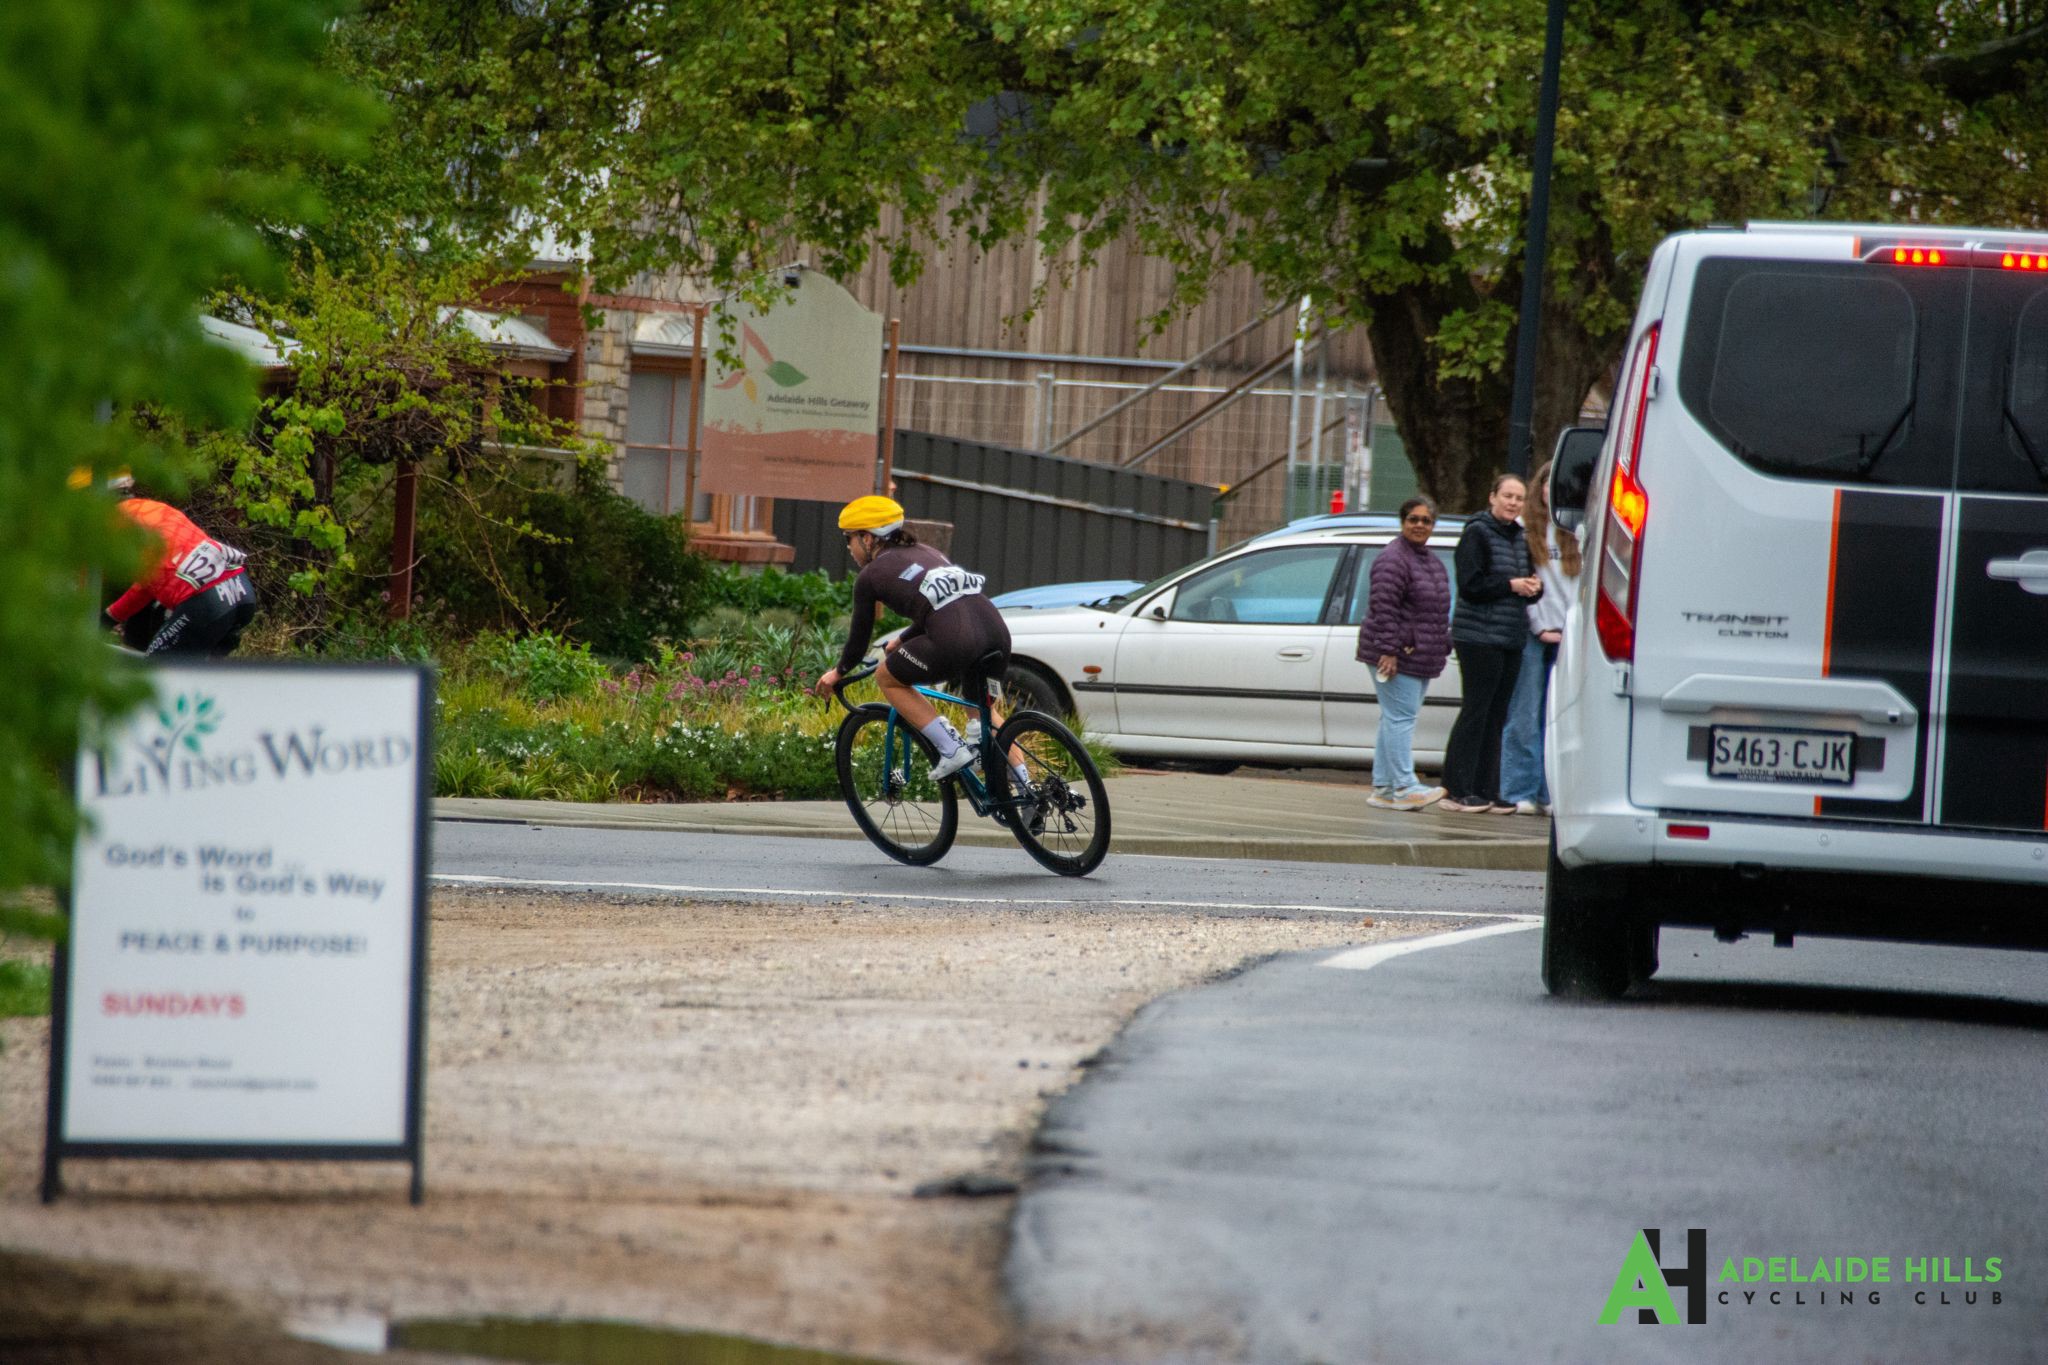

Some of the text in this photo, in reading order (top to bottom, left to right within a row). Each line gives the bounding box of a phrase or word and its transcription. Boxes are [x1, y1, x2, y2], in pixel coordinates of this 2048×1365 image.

[767, 394, 870, 411] Adelaide Hills Getaway
[183, 553, 217, 584] 122
[927, 574, 959, 604] 205
[162, 614, 190, 641] PANTRY
[1681, 611, 1789, 626] TRANSIT
[1718, 629, 1789, 639] CUSTOM
[898, 647, 928, 671] ATTAQUER
[105, 844, 188, 868] God's
[198, 846, 273, 869] Word
[236, 872, 317, 894] God's
[328, 874, 386, 899] Way
[236, 905, 255, 922] to
[120, 931, 205, 951] PEACE
[214, 933, 231, 952] &
[102, 992, 246, 1018] SUNDAYS
